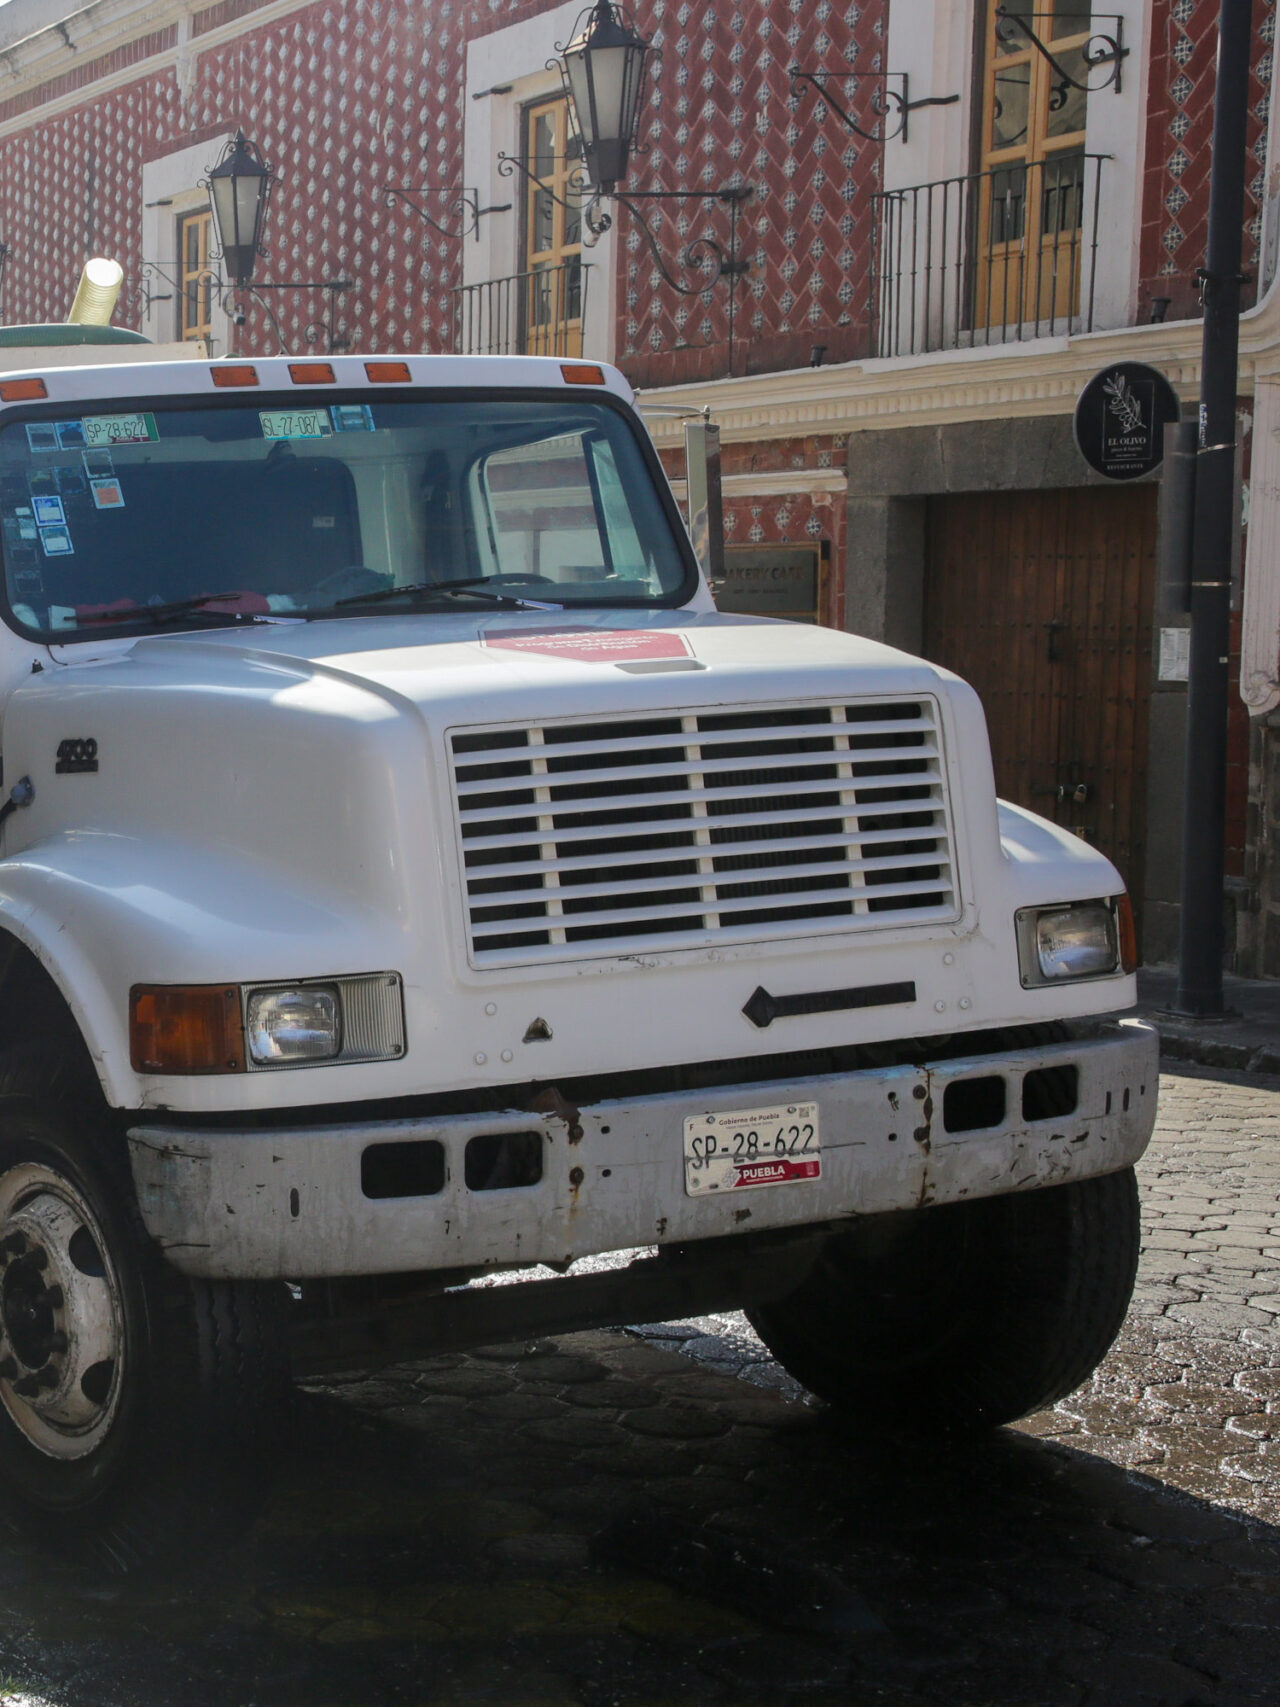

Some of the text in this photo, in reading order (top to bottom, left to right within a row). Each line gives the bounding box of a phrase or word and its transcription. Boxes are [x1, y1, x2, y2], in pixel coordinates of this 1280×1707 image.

[86, 421, 147, 439] SP-28-622
[261, 415, 317, 437] SL-27-087
[1108, 437, 1147, 446] EL OLIVO
[725, 566, 769, 580] AKERY
[718, 1115, 748, 1126] Gobierno
[758, 1112, 780, 1121] Puebla
[691, 1124, 814, 1170] SP-28-622
[742, 1165, 786, 1179] PUEBLA
